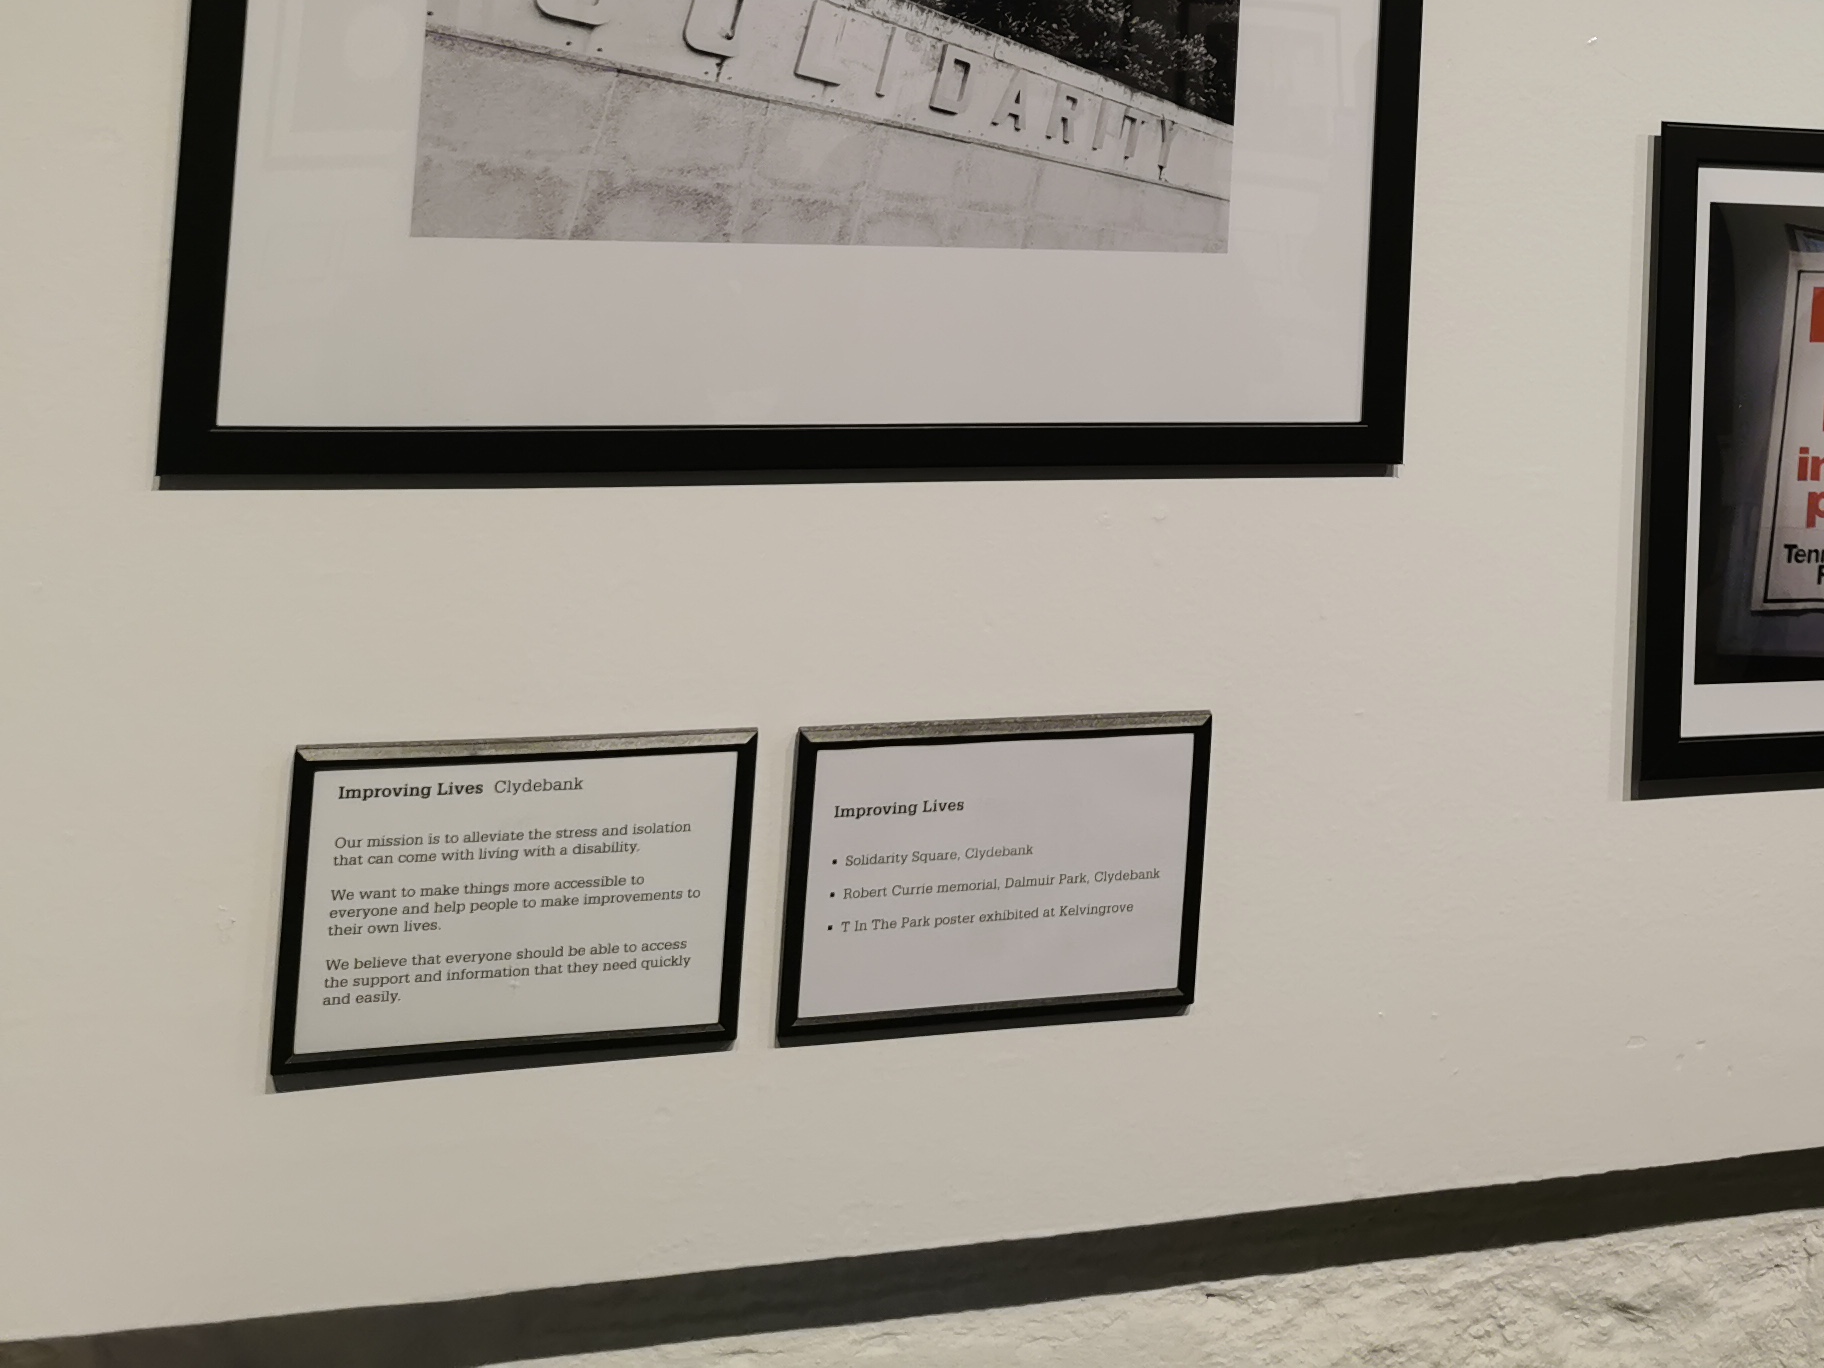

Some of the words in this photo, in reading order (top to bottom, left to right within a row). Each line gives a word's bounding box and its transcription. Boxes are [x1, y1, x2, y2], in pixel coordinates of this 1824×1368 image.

[339, 784, 432, 801] Improving
[437, 782, 483, 795] Lives
[495, 777, 583, 795] Clydebank
[834, 802, 918, 819] Improving
[923, 800, 964, 812] Lives
[335, 837, 363, 848] Our
[367, 835, 424, 847] mission
[428, 833, 440, 845] is
[445, 834, 459, 844] to
[463, 831, 524, 843] alleviate
[528, 829, 552, 840] the
[556, 828, 598, 838] stress
[602, 824, 628, 836] and
[632, 822, 691, 835] isolation
[334, 855, 363, 866] that
[367, 855, 393, 864] can
[398, 853, 437, 863] come
[441, 849, 475, 861] with
[479, 847, 519, 861] living
[523, 845, 555, 857] with
[560, 847, 568, 855] a
[572, 842, 640, 855] disability.
[845, 853, 908, 866] Solidarity
[912, 851, 960, 863] Square,
[965, 845, 1033, 860] Clydebank
[331, 889, 354, 901] We
[359, 888, 397, 899] want
[401, 888, 416, 897] to
[420, 884, 460, 897] make
[464, 882, 509, 895] things
[513, 882, 550, 892] more
[554, 875, 626, 889] accessible
[631, 876, 645, 885] to
[843, 887, 887, 899] Robert
[892, 884, 933, 896] Currie
[936, 879, 1000, 893] memorial,
[1005, 875, 1055, 889] Dalmuir
[1059, 873, 1089, 885] Park,
[1094, 868, 1160, 884] Clydebank
[329, 907, 398, 919] everyone
[402, 902, 429, 914] and
[434, 901, 466, 914] help
[469, 898, 518, 914] people
[523, 899, 537, 908] to
[540, 895, 579, 907] make
[584, 890, 683, 906] improvements
[688, 889, 701, 898] to
[328, 924, 363, 936] their
[367, 924, 399, 934] own
[404, 920, 441, 932] lives.
[841, 921, 851, 932] T
[855, 920, 867, 932] In
[871, 919, 897, 930] The
[901, 916, 930, 928] Park
[934, 915, 975, 928] poster
[979, 907, 1039, 922] exhibited
[1043, 908, 1055, 917] at
[1059, 904, 1134, 916] Kelvingrove
[326, 959, 349, 971] We
[354, 957, 407, 969] believe
[412, 954, 441, 965] that
[445, 952, 512, 964] everyone
[517, 946, 564, 959] should
[568, 946, 586, 956] be
[590, 943, 620, 955] able
[624, 943, 637, 952] to
[641, 941, 687, 952] access
[325, 977, 348, 988] the
[353, 974, 410, 988] support
[414, 970, 442, 983] and
[447, 966, 530, 981] information
[535, 964, 563, 975] that
[567, 962, 599, 974] they
[603, 958, 637, 971] need
[641, 955, 691, 970] quickly
[323, 993, 351, 1006] and
[355, 991, 401, 1004] easily.
